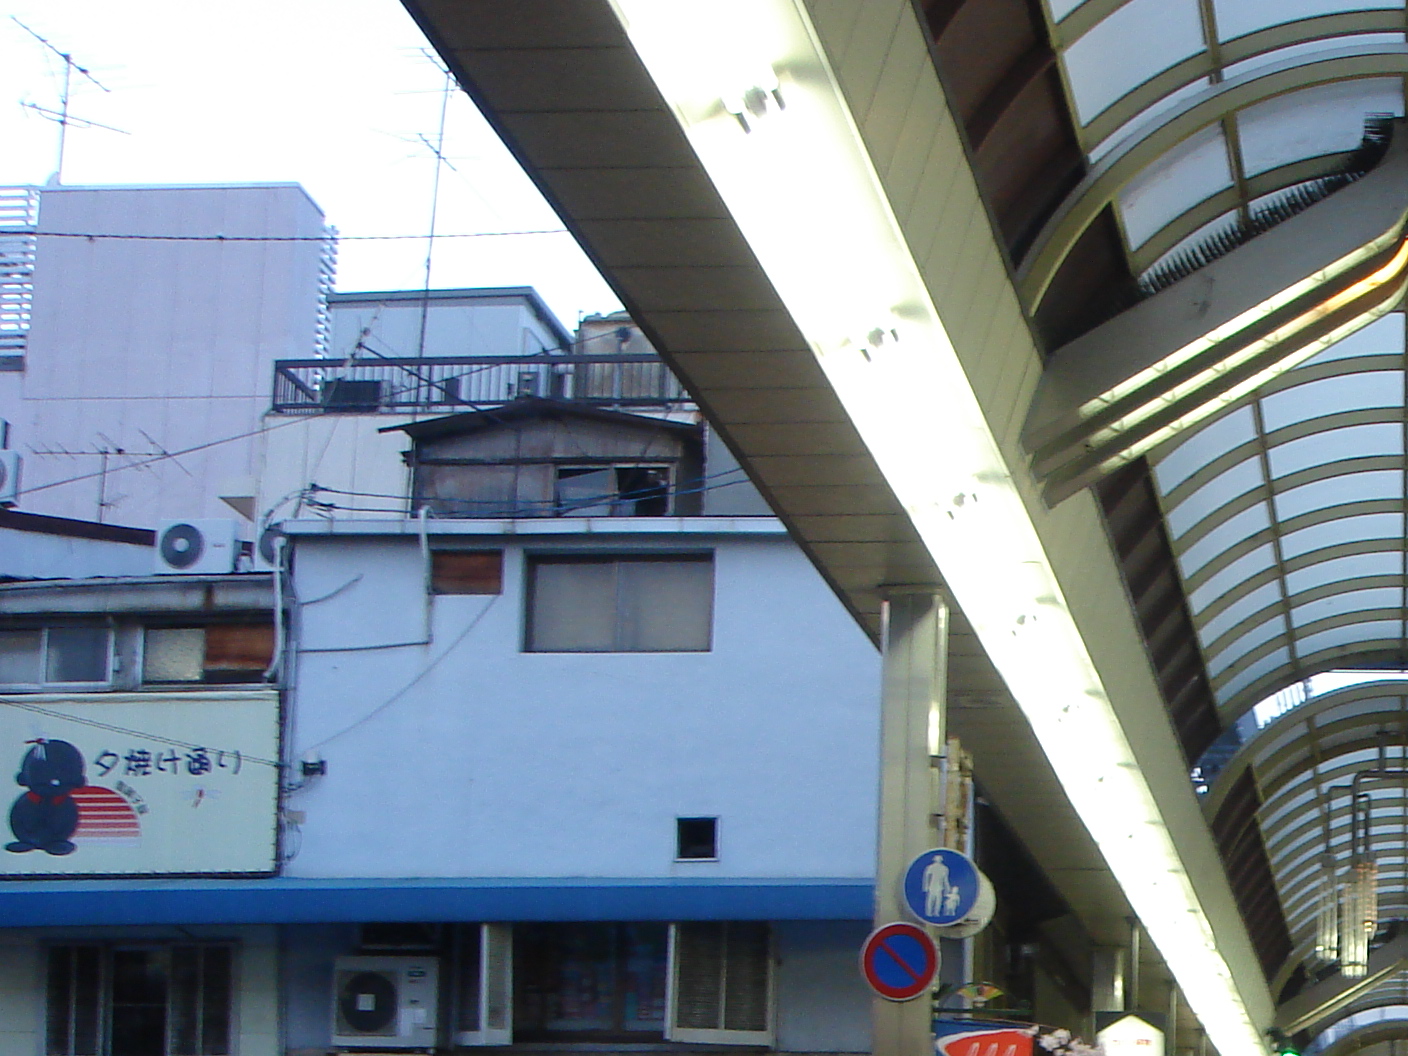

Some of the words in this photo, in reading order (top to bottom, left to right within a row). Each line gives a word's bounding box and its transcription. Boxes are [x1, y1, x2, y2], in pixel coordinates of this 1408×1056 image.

[94, 747, 242, 778] 夕焼け通り
